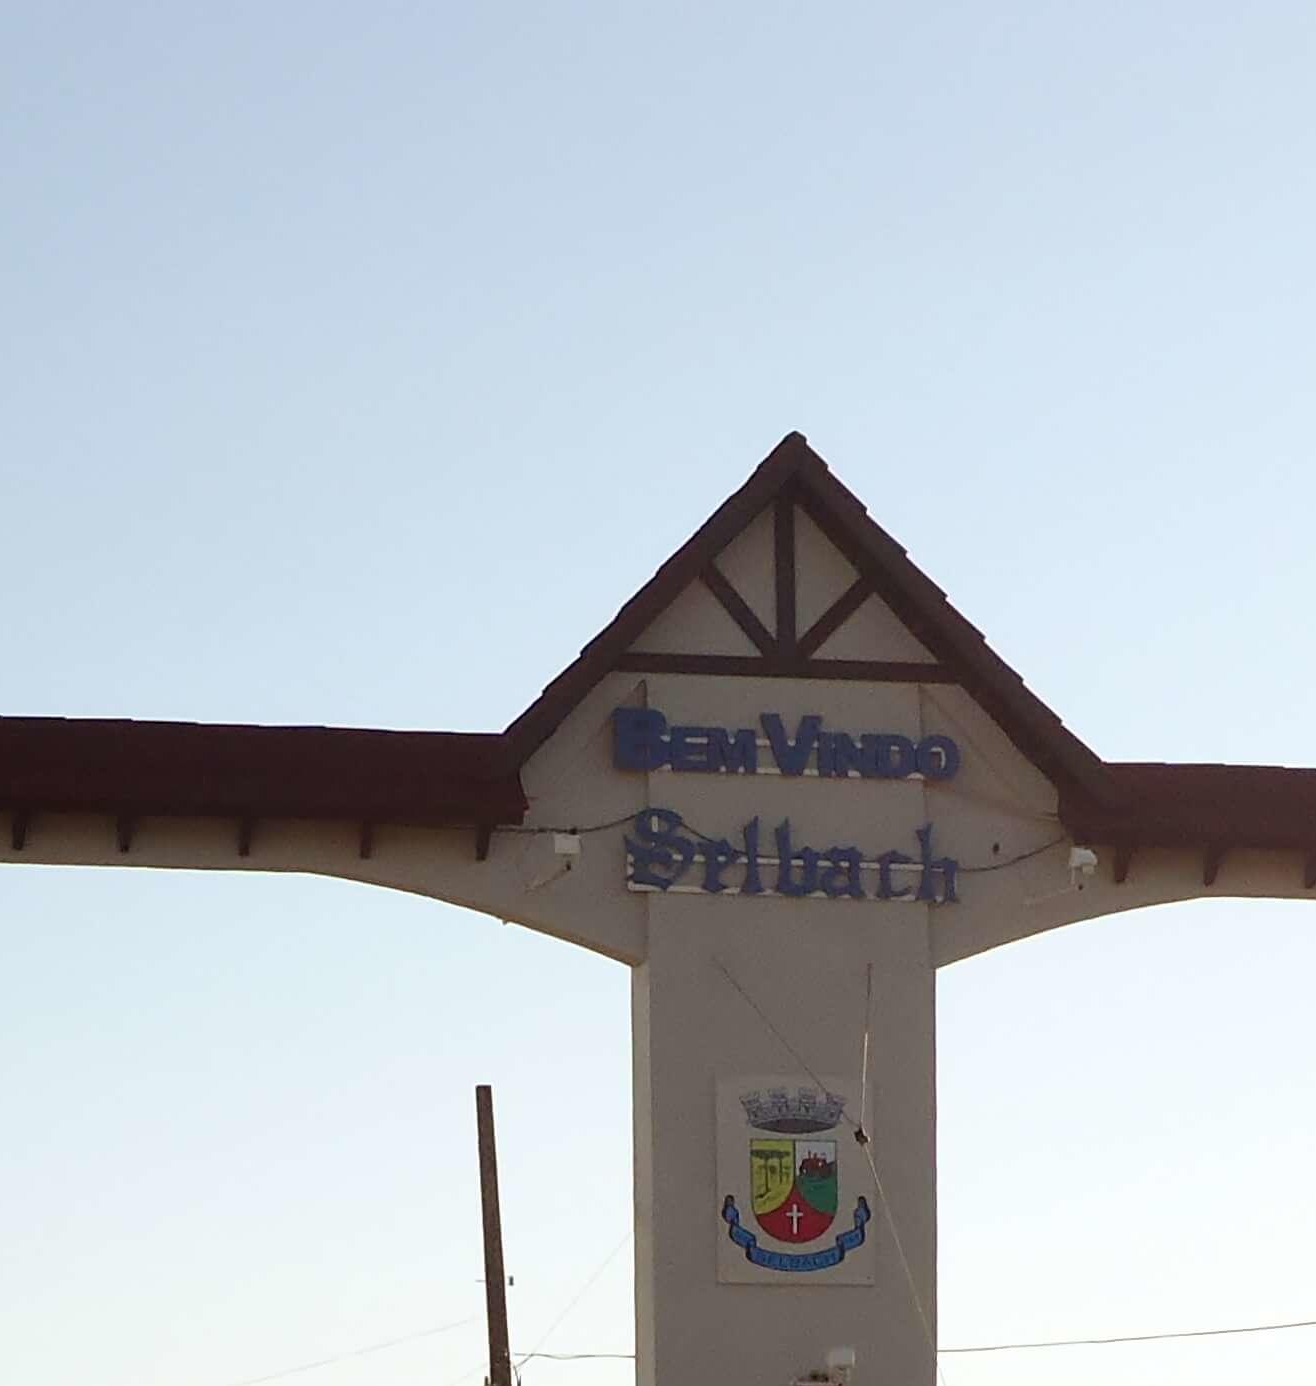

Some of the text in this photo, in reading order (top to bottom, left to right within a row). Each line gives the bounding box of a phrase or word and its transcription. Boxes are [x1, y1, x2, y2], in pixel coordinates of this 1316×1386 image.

[611, 706, 962, 781] BEM VINDO
[624, 807, 960, 904] Selbach
